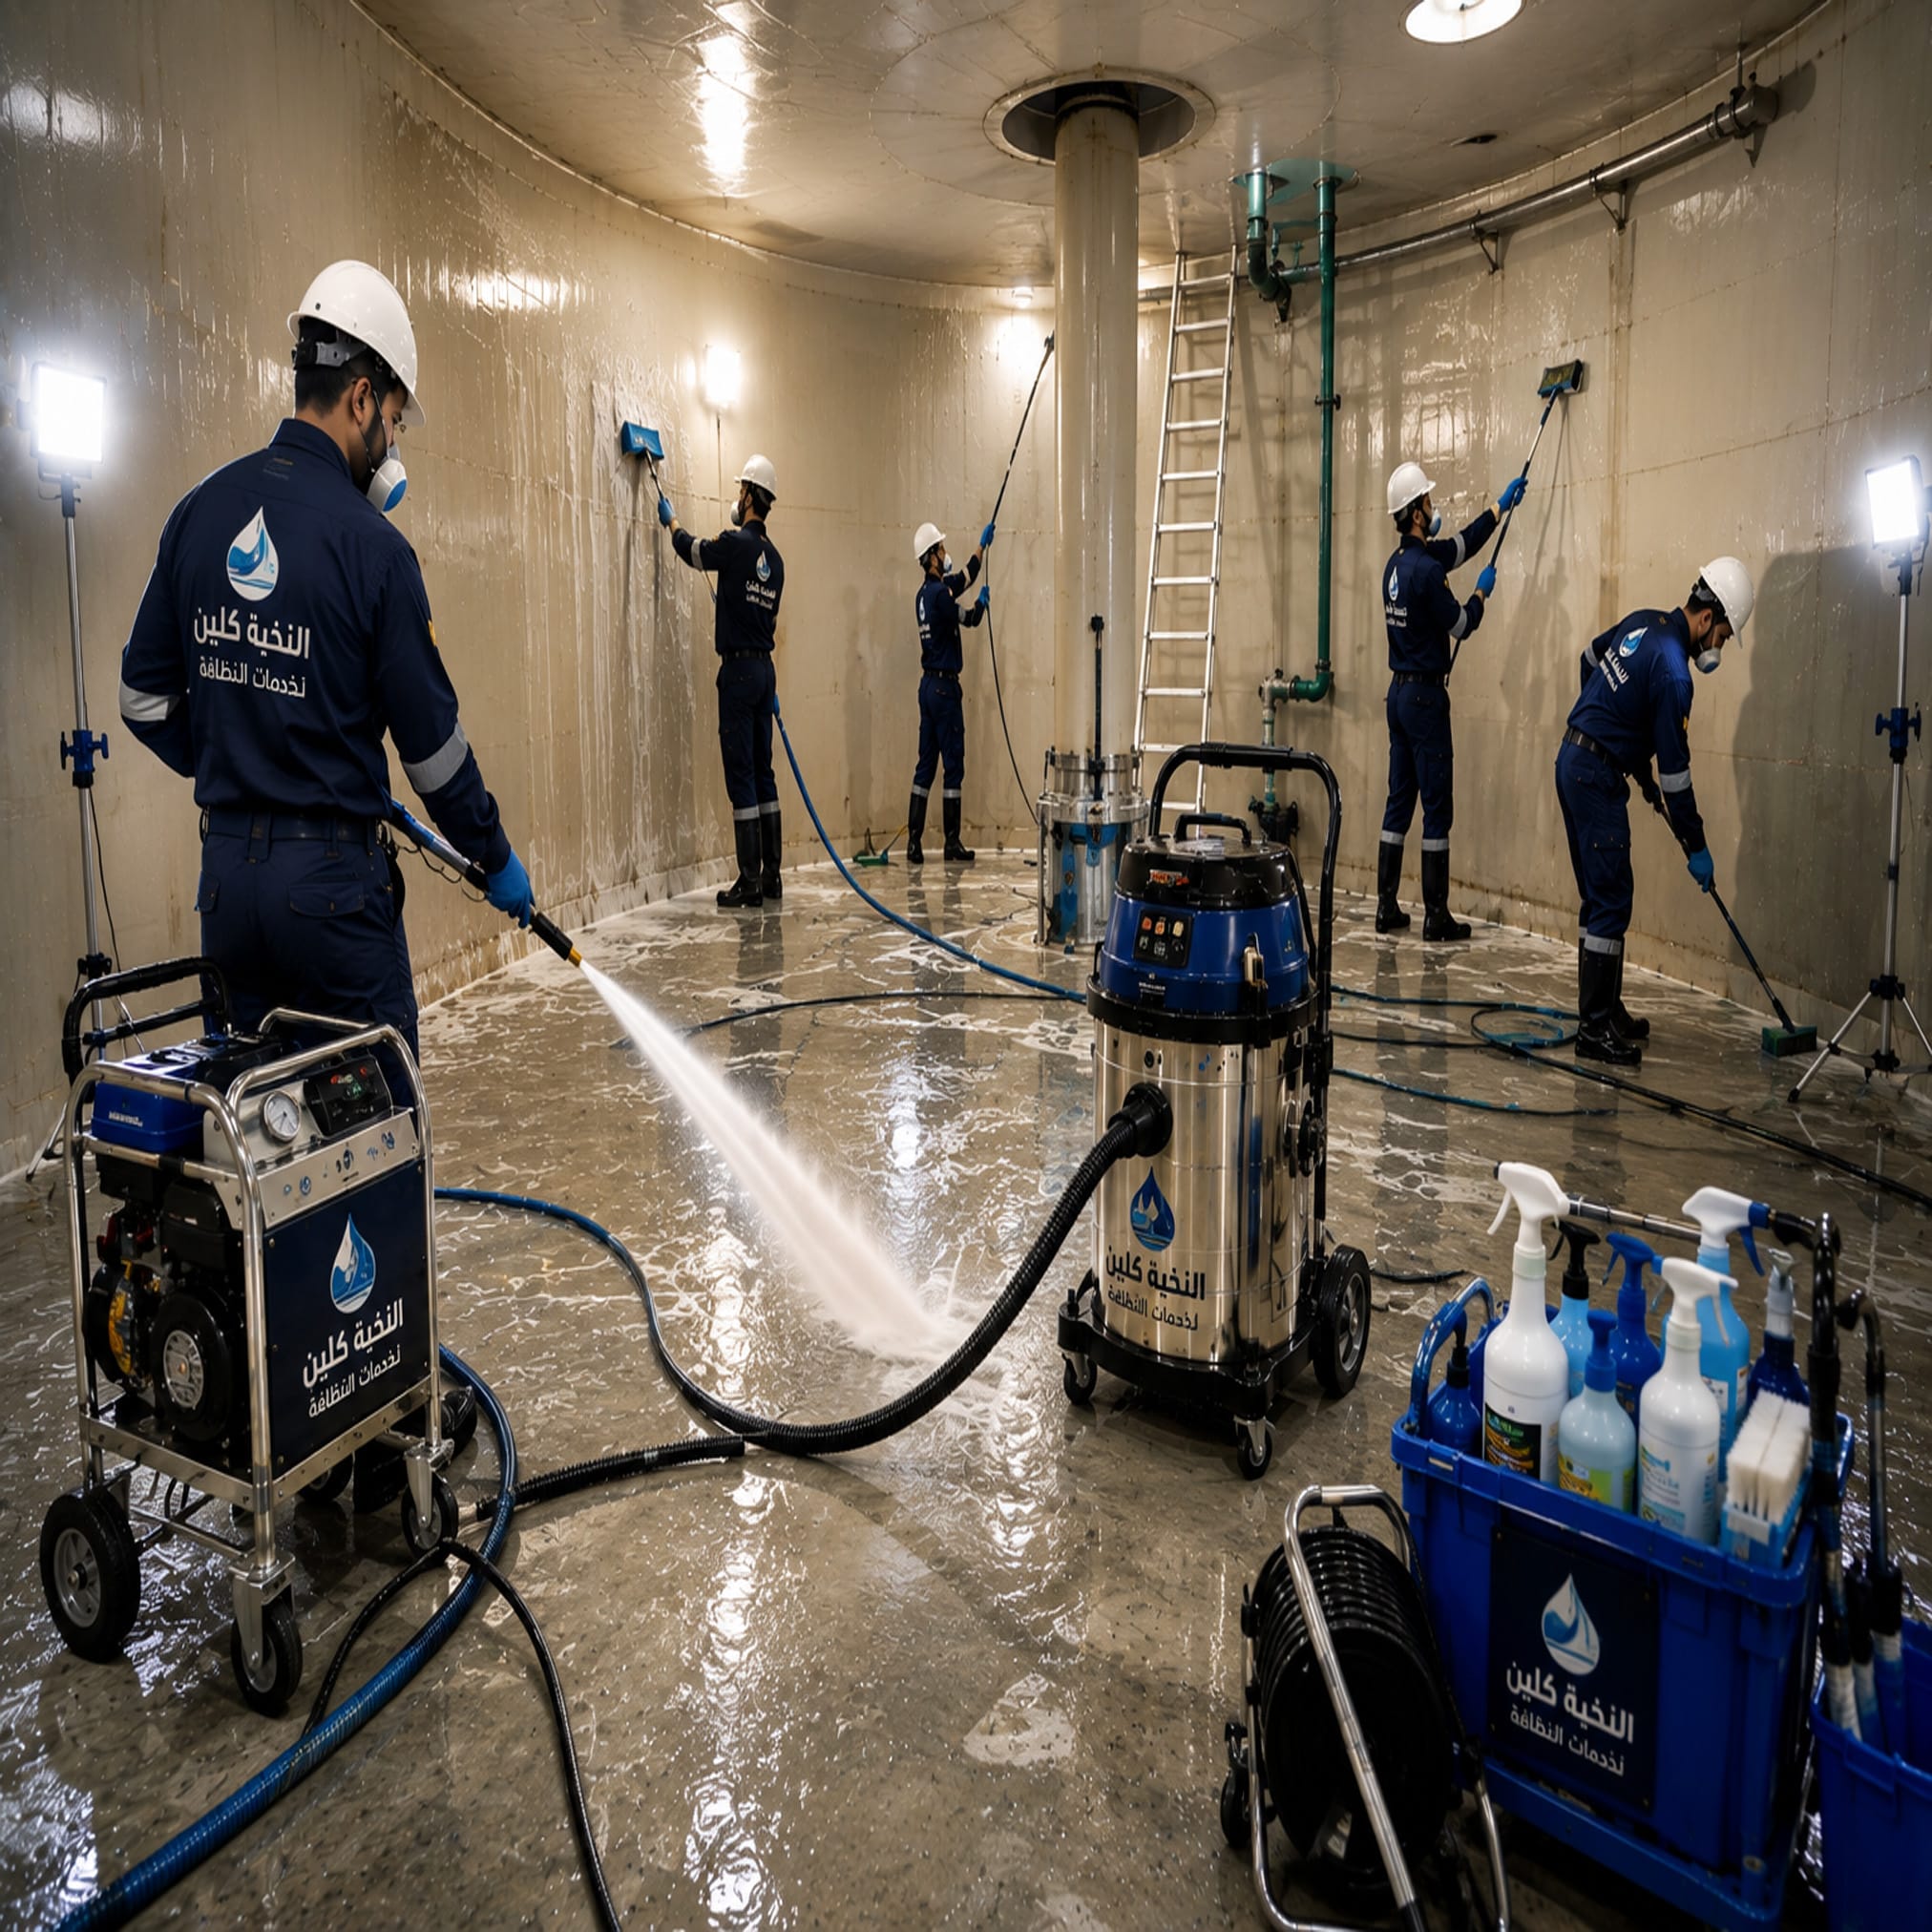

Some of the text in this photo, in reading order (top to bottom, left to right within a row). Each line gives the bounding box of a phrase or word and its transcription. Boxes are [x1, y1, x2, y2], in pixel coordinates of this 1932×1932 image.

[194, 605, 242, 647] كلين
[1105, 1244, 1143, 1284] كلين
[303, 1329, 349, 1389] كلين
[1505, 1660, 1558, 1707] كلين
